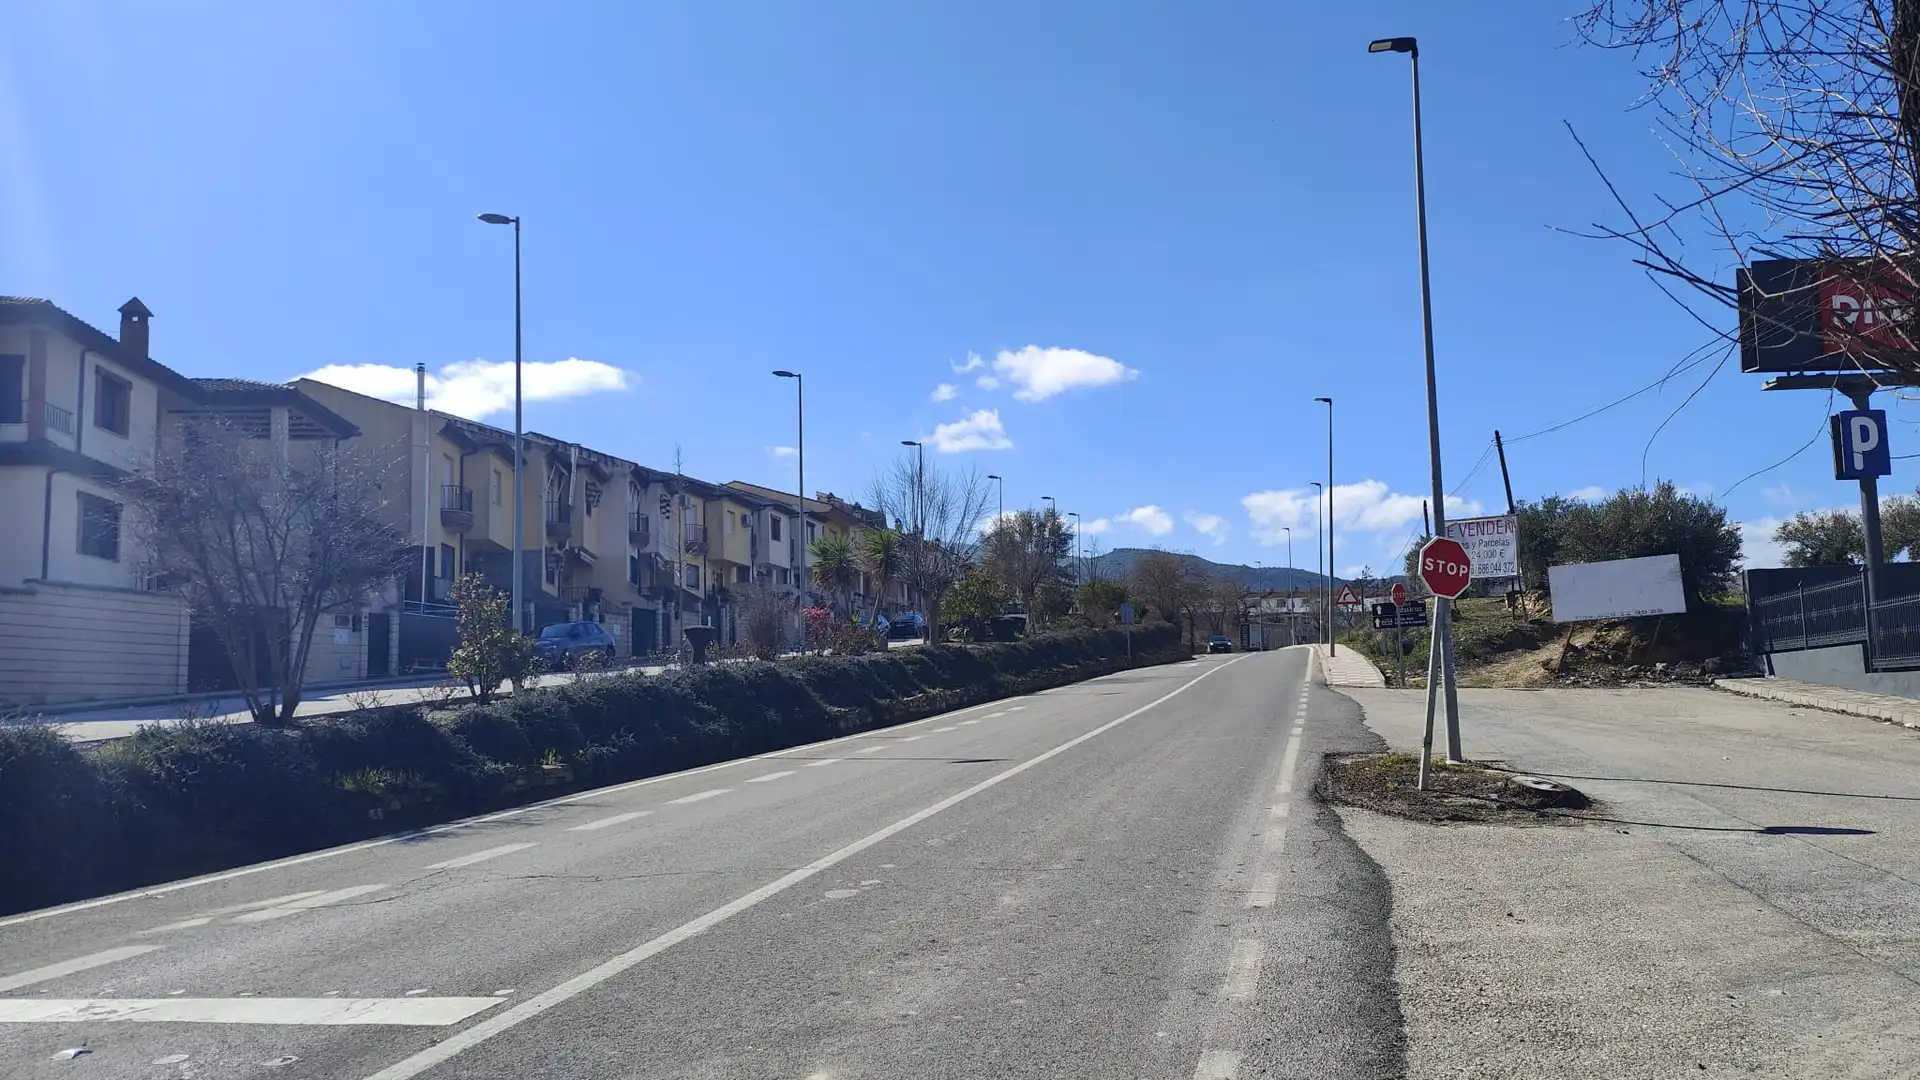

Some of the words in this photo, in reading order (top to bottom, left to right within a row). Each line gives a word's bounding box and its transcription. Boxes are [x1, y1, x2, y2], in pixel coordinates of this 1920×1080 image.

[1850, 416, 1879, 470] P
[1458, 519, 1515, 537] VENDEN
[1479, 538, 1510, 548] Parcelas
[1424, 557, 1469, 577] STOP
